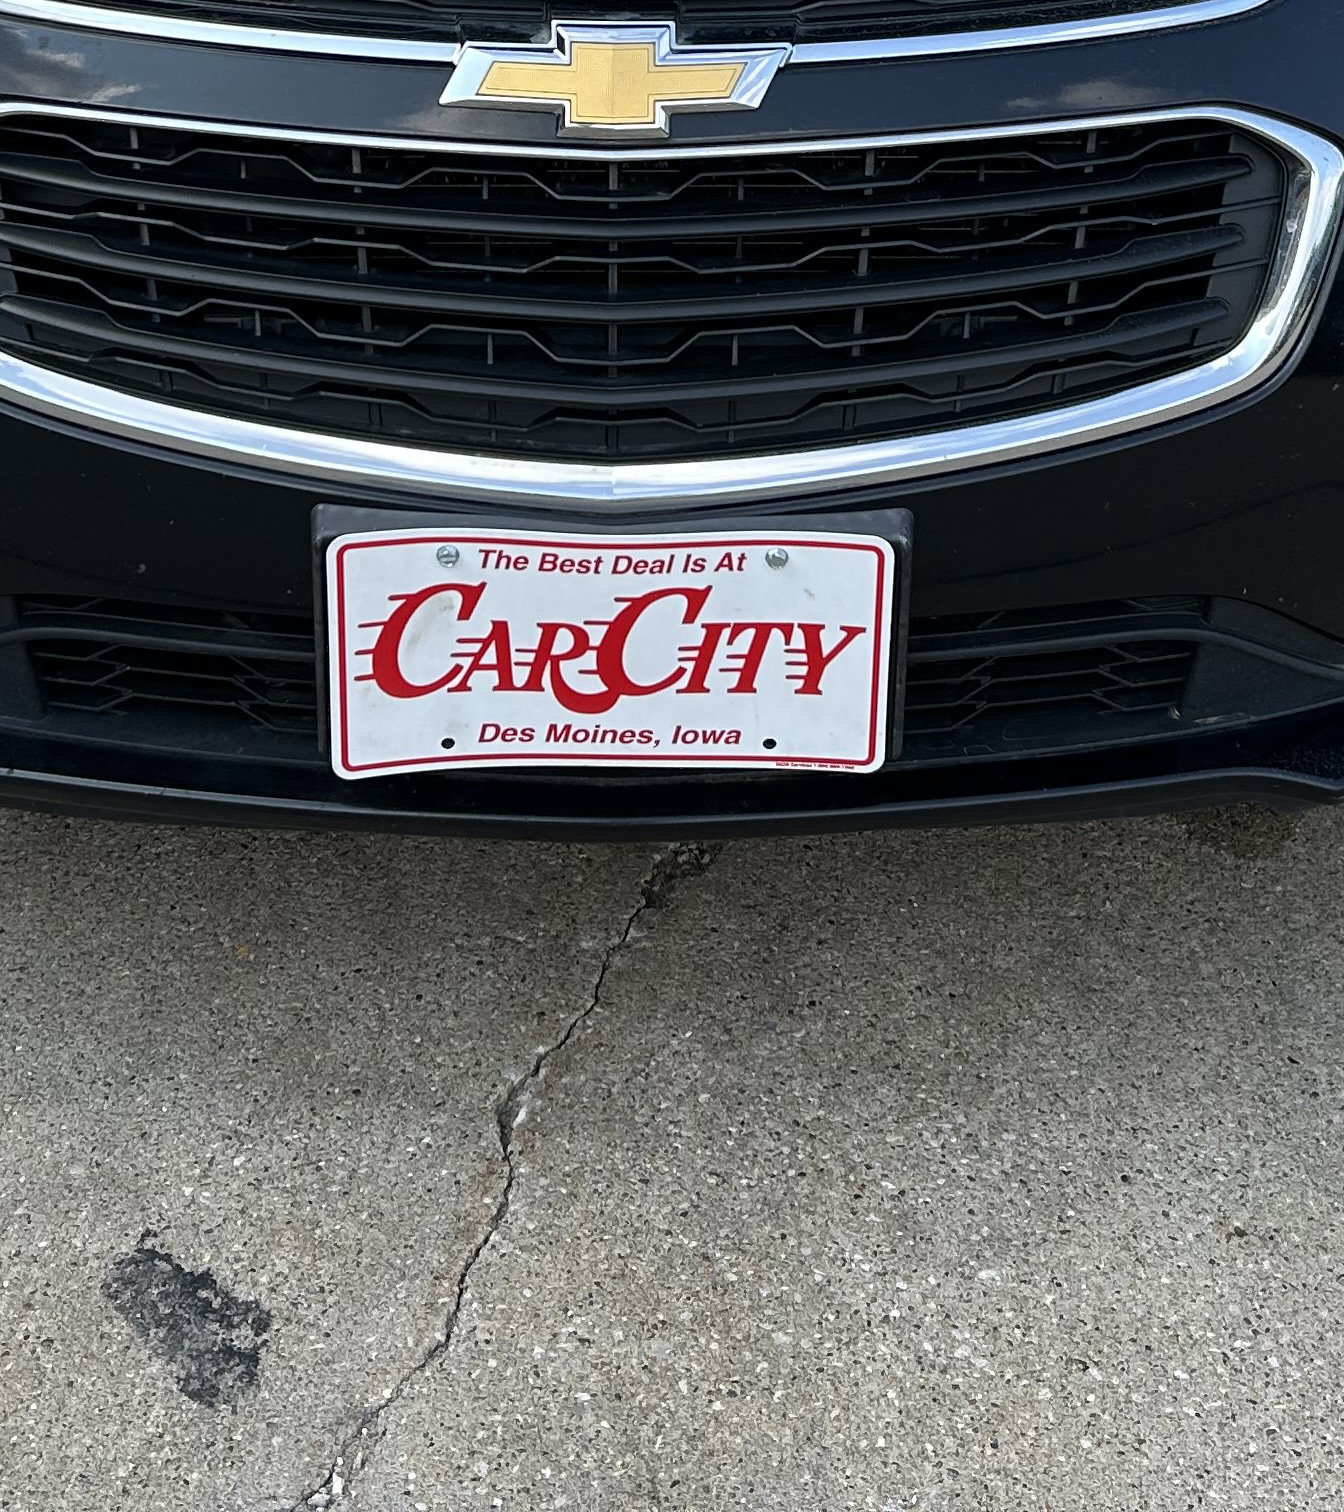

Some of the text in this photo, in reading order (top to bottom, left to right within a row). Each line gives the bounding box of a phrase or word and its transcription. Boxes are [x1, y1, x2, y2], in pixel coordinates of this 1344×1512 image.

[478, 548, 747, 575] The Best Deal Is At
[477, 723, 743, 748] Des Moines, Iowa
